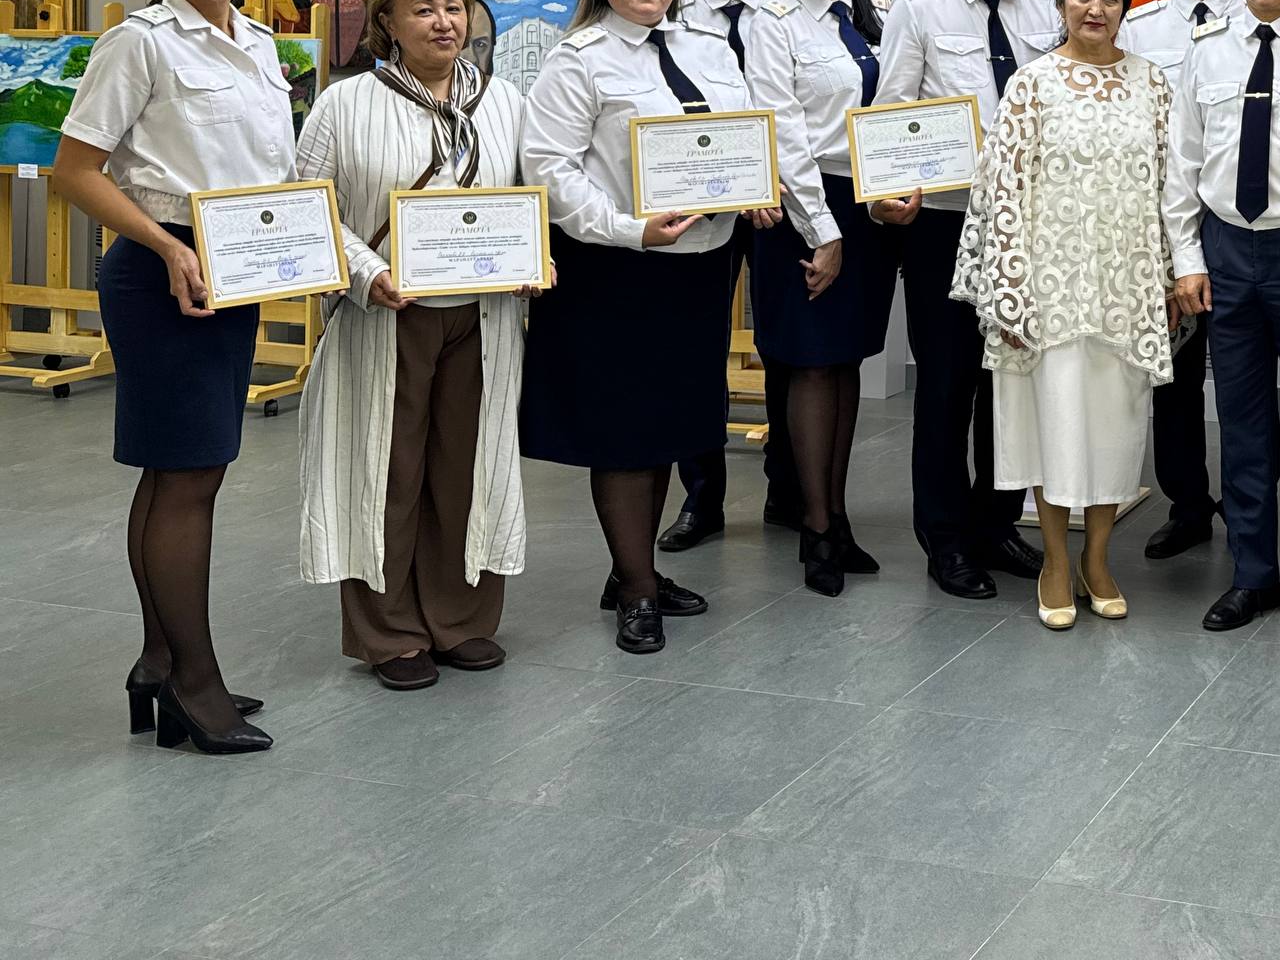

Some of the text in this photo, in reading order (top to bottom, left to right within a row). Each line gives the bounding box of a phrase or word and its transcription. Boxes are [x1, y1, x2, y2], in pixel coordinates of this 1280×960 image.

[898, 134, 933, 144] ГРАМОТА
[686, 149, 724, 158] ГРАМОТА
[251, 225, 289, 237] ГРАМОТА
[449, 226, 491, 235] ГРАМОТА
